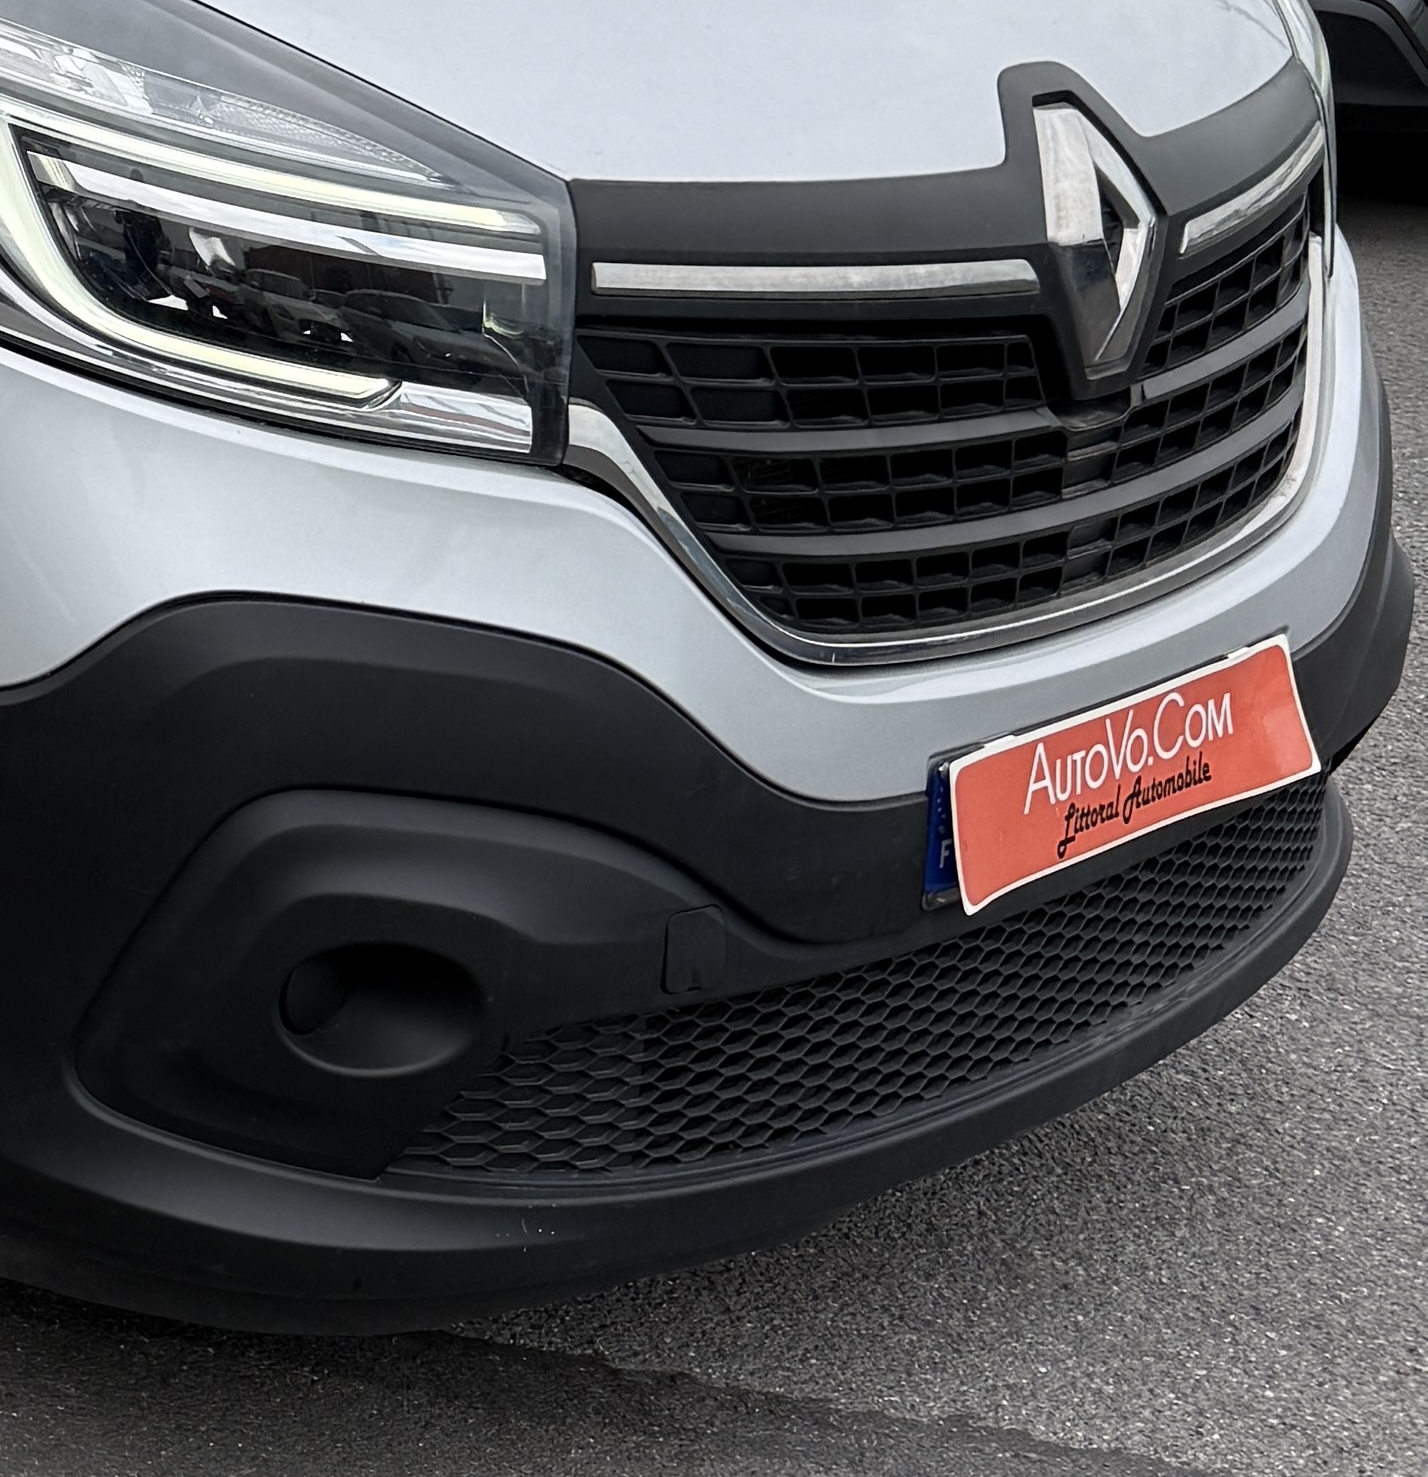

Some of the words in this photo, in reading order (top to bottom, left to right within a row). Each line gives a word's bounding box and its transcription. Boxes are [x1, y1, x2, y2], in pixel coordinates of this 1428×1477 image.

[1057, 783, 1121, 859] Littoral
[1123, 751, 1212, 823] Automobile
[939, 838, 953, 869] F
